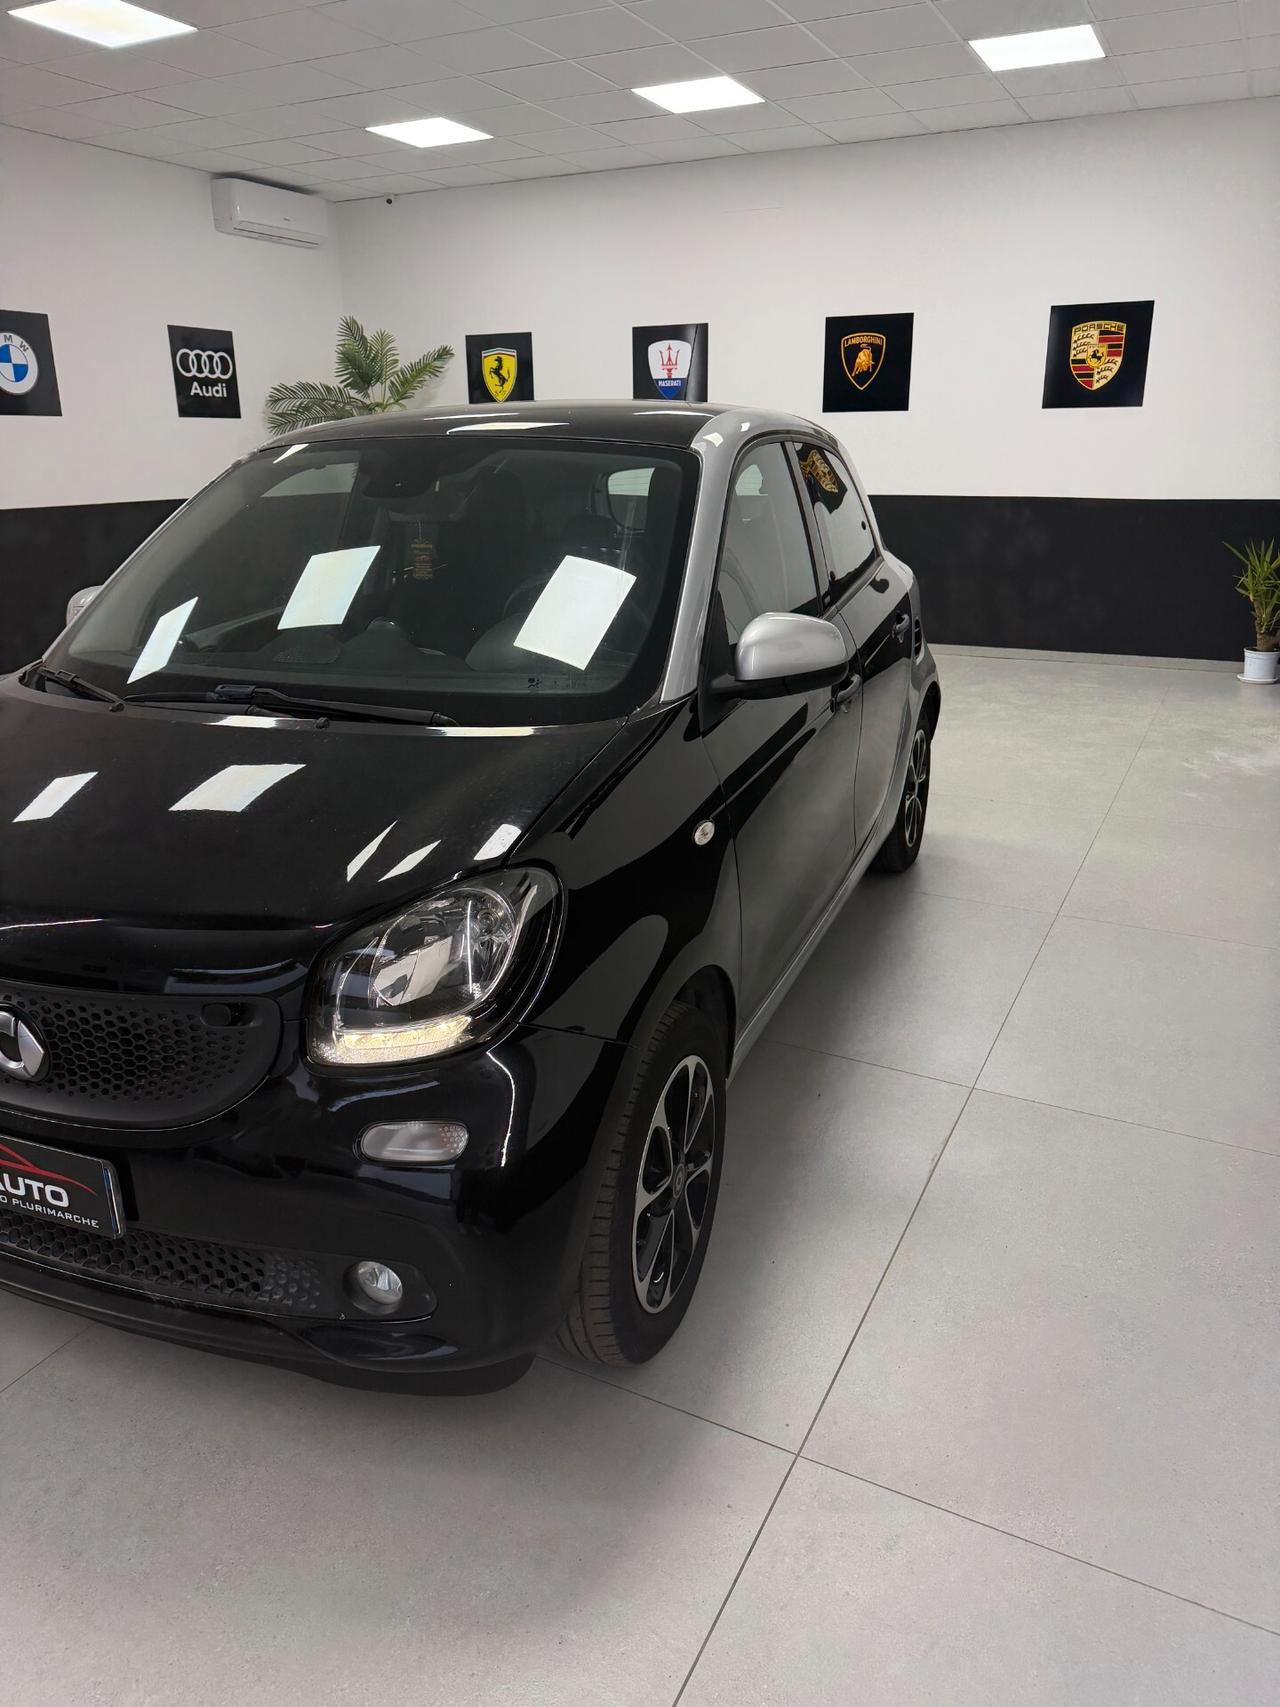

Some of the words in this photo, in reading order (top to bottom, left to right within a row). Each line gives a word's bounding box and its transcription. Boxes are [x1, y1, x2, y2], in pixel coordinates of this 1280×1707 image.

[1074, 322, 1124, 335] PORSCHE
[3, 334, 29, 352] MW
[844, 335, 883, 347] LAMBORGHINI
[190, 381, 227, 398] Audi
[658, 379, 681, 387] MASERATI
[12, 1197, 99, 1229] PLURIMARCHE
